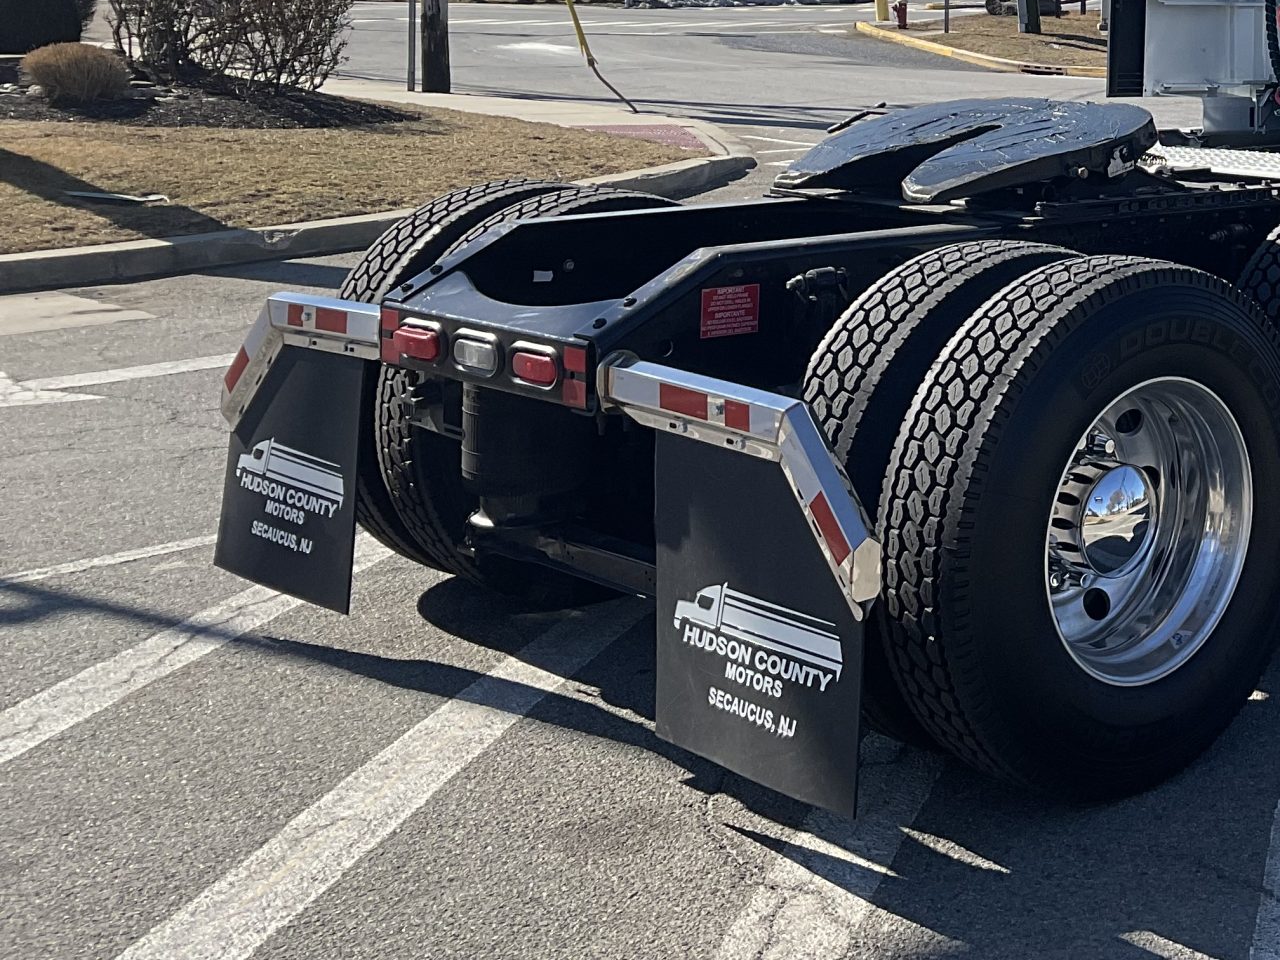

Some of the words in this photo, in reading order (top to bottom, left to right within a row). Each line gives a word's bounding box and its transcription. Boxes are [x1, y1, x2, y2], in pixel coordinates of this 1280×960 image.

[240, 472, 286, 502] HUDSON
[286, 489, 338, 519] COUNTY
[264, 500, 305, 525] MOTORS
[251, 520, 298, 552] SECAUCUS,
[299, 538, 313, 554] NJ
[682, 624, 753, 665] HUDSON
[754, 650, 833, 692] COUNTY
[725, 662, 784, 698] MOTORS
[708, 686, 775, 733] SECAUCUS,
[778, 714, 798, 738] NJ
